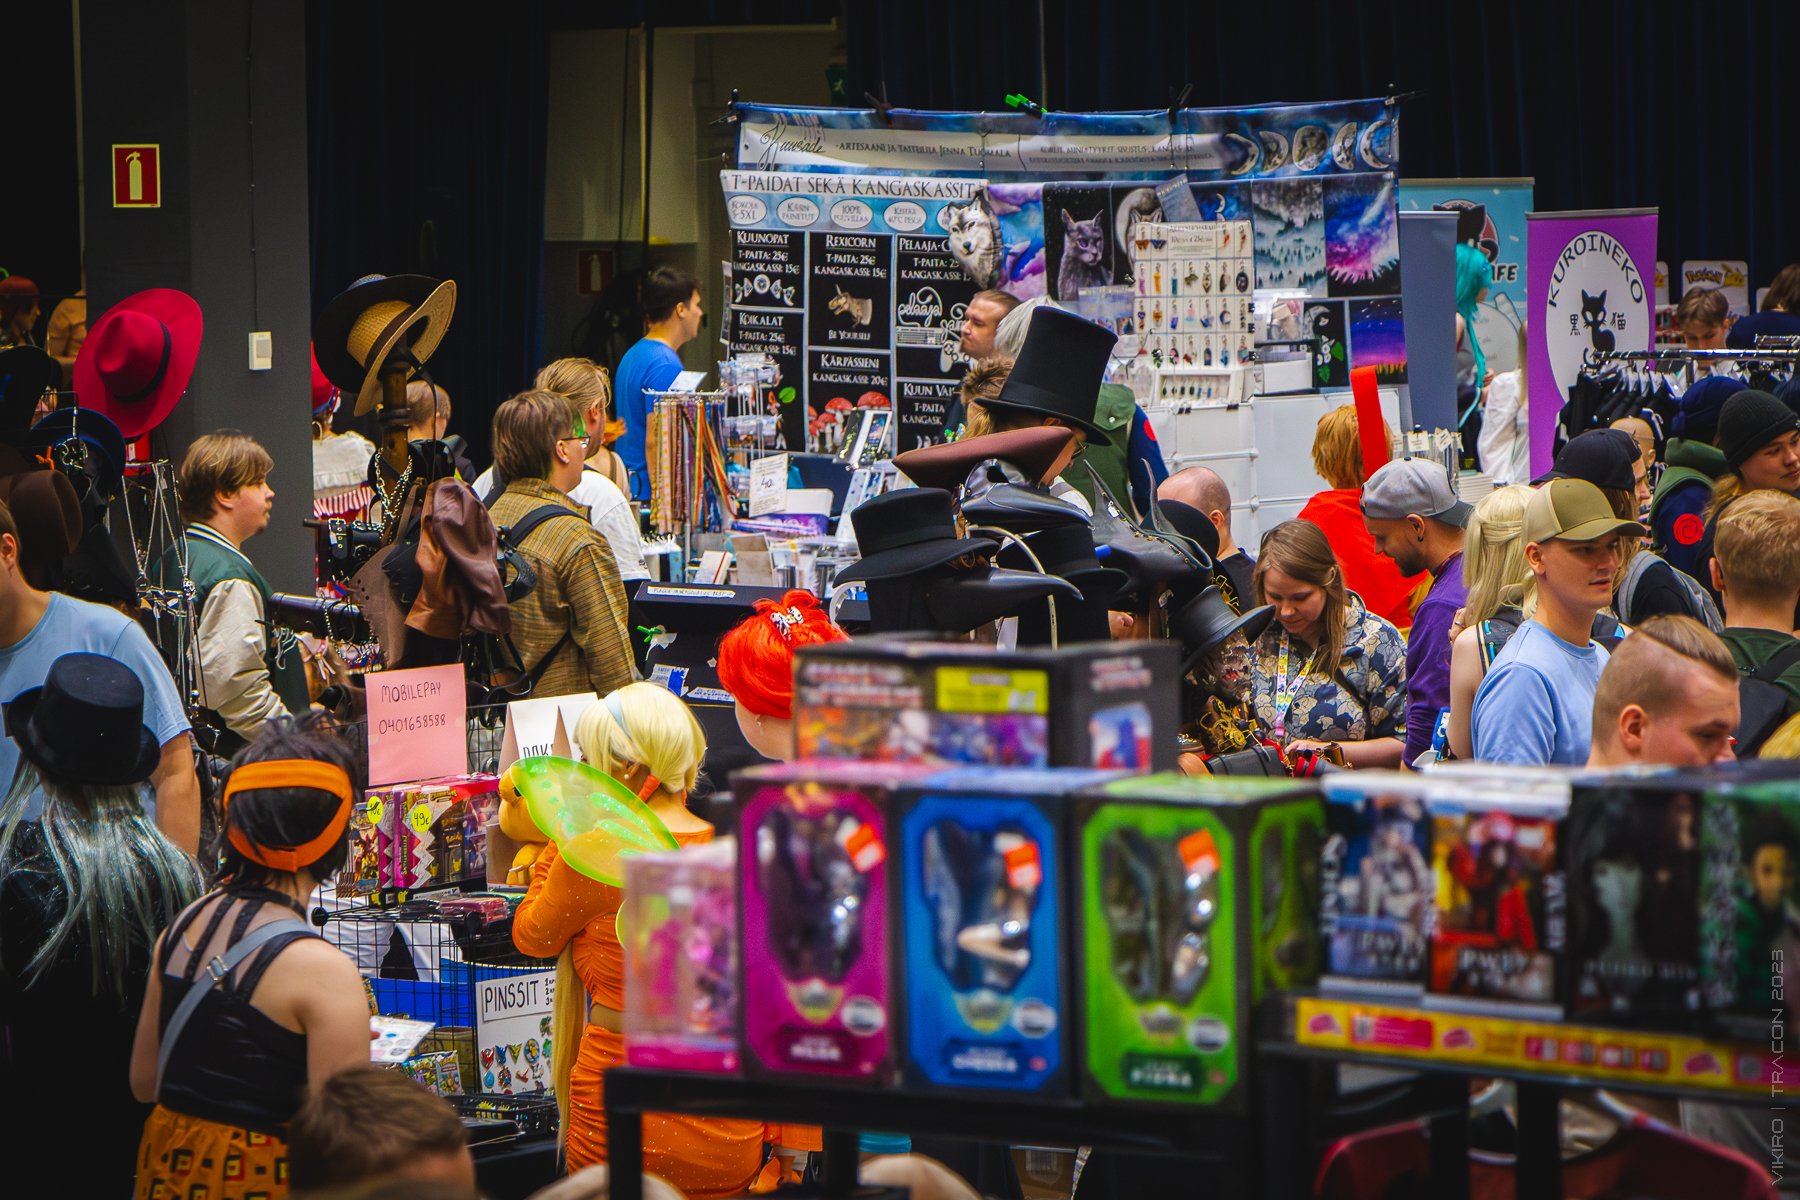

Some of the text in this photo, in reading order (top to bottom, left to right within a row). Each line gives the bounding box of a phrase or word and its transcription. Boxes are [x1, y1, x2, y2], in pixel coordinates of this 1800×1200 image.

[732, 174, 975, 199] T-PAIDAT SEKÄ KANGASKASSIT
[736, 230, 790, 245] KUUNOPAT
[825, 234, 877, 248] REXICORN
[738, 249, 789, 262] T-PAITA: 25€
[826, 253, 876, 265] T-PAITA: 25€
[913, 257, 948, 267] T-PAITA:
[785, 263, 800, 275] 15€
[872, 267, 887, 279] 15€
[1548, 234, 1643, 308] KUROINEKO
[739, 312, 784, 327] KOIKALAT
[738, 331, 785, 343] T-PAITA: 25€
[870, 374, 889, 387] 20€
[903, 382, 933, 396] KUUN
[381, 681, 441, 703] MOBILEPAY
[378, 713, 446, 735] 0401658588
[484, 980, 539, 1013] PINSSIT
